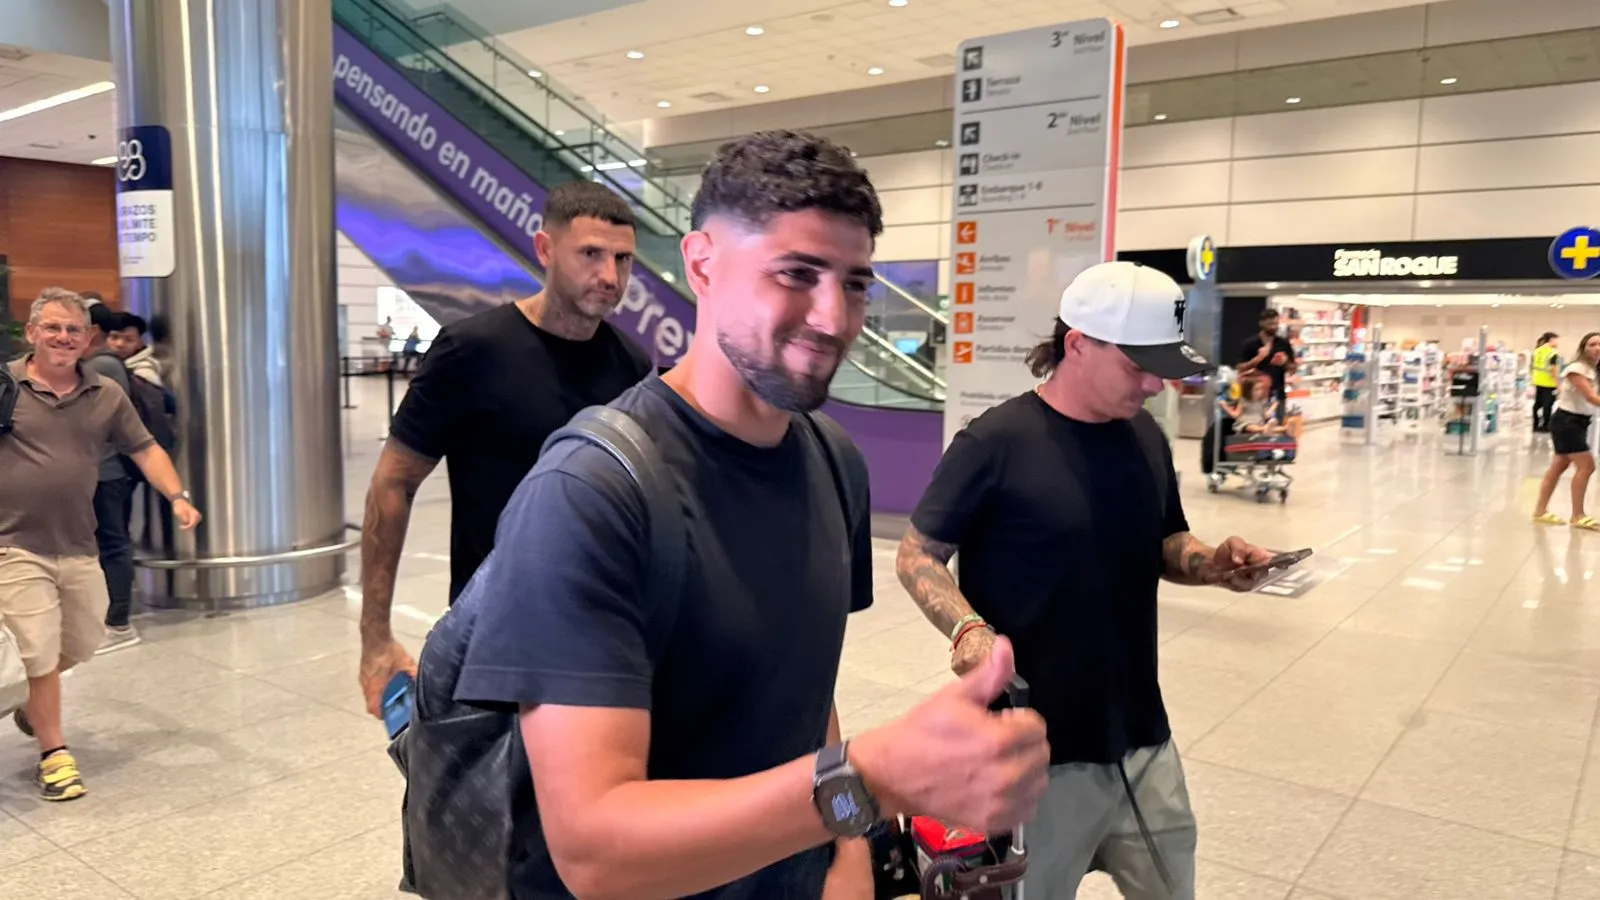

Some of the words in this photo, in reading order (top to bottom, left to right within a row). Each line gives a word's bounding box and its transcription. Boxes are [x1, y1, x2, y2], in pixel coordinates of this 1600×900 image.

[1073, 30, 1106, 45] Nivel
[333, 54, 437, 151] pensando
[438, 141, 471, 179] en
[1069, 112, 1101, 127] Nivel
[1065, 220, 1096, 234] Nivel
[1333, 257, 1380, 277] SAN
[1380, 256, 1459, 276] ROQUE
[614, 274, 697, 364] pre
